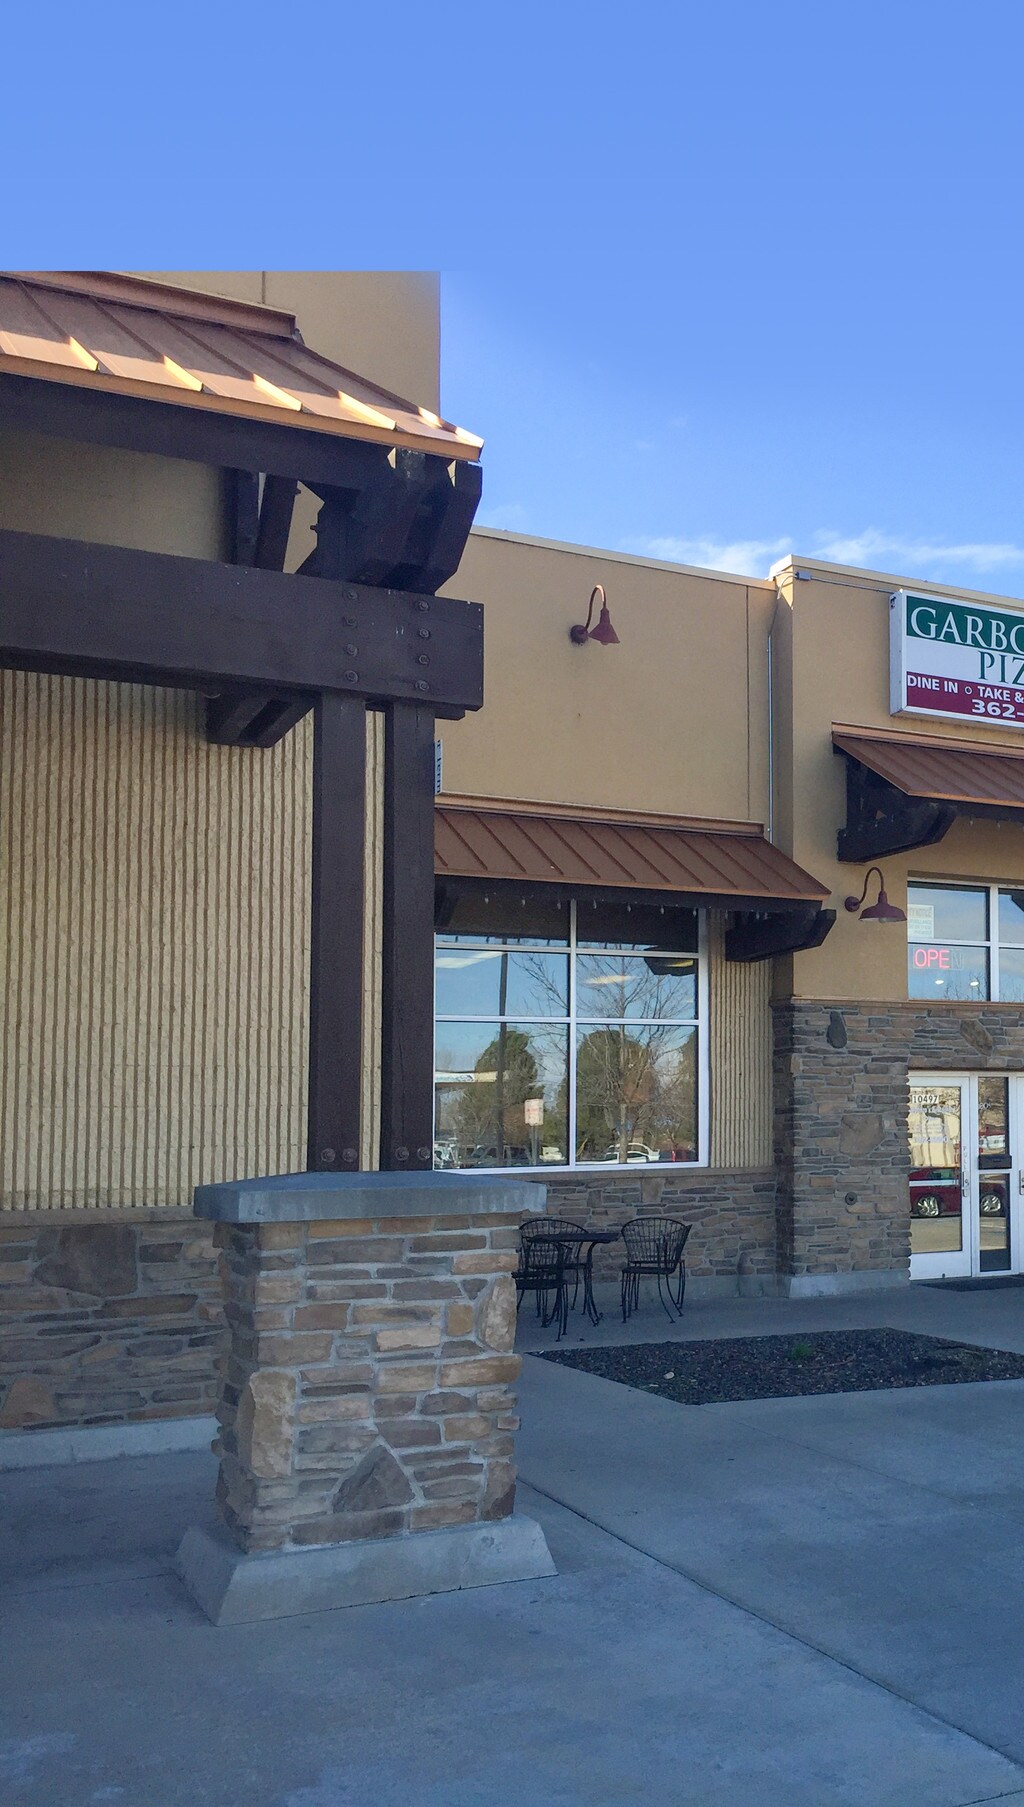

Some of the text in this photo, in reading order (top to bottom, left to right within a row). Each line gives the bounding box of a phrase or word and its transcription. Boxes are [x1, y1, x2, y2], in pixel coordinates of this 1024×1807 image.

[907, 675, 940, 691] DINE
[944, 680, 959, 694] IN
[977, 686, 1011, 701] TAKE
[1014, 691, 1024, 704] &
[913, 1095, 938, 1104] 10497
